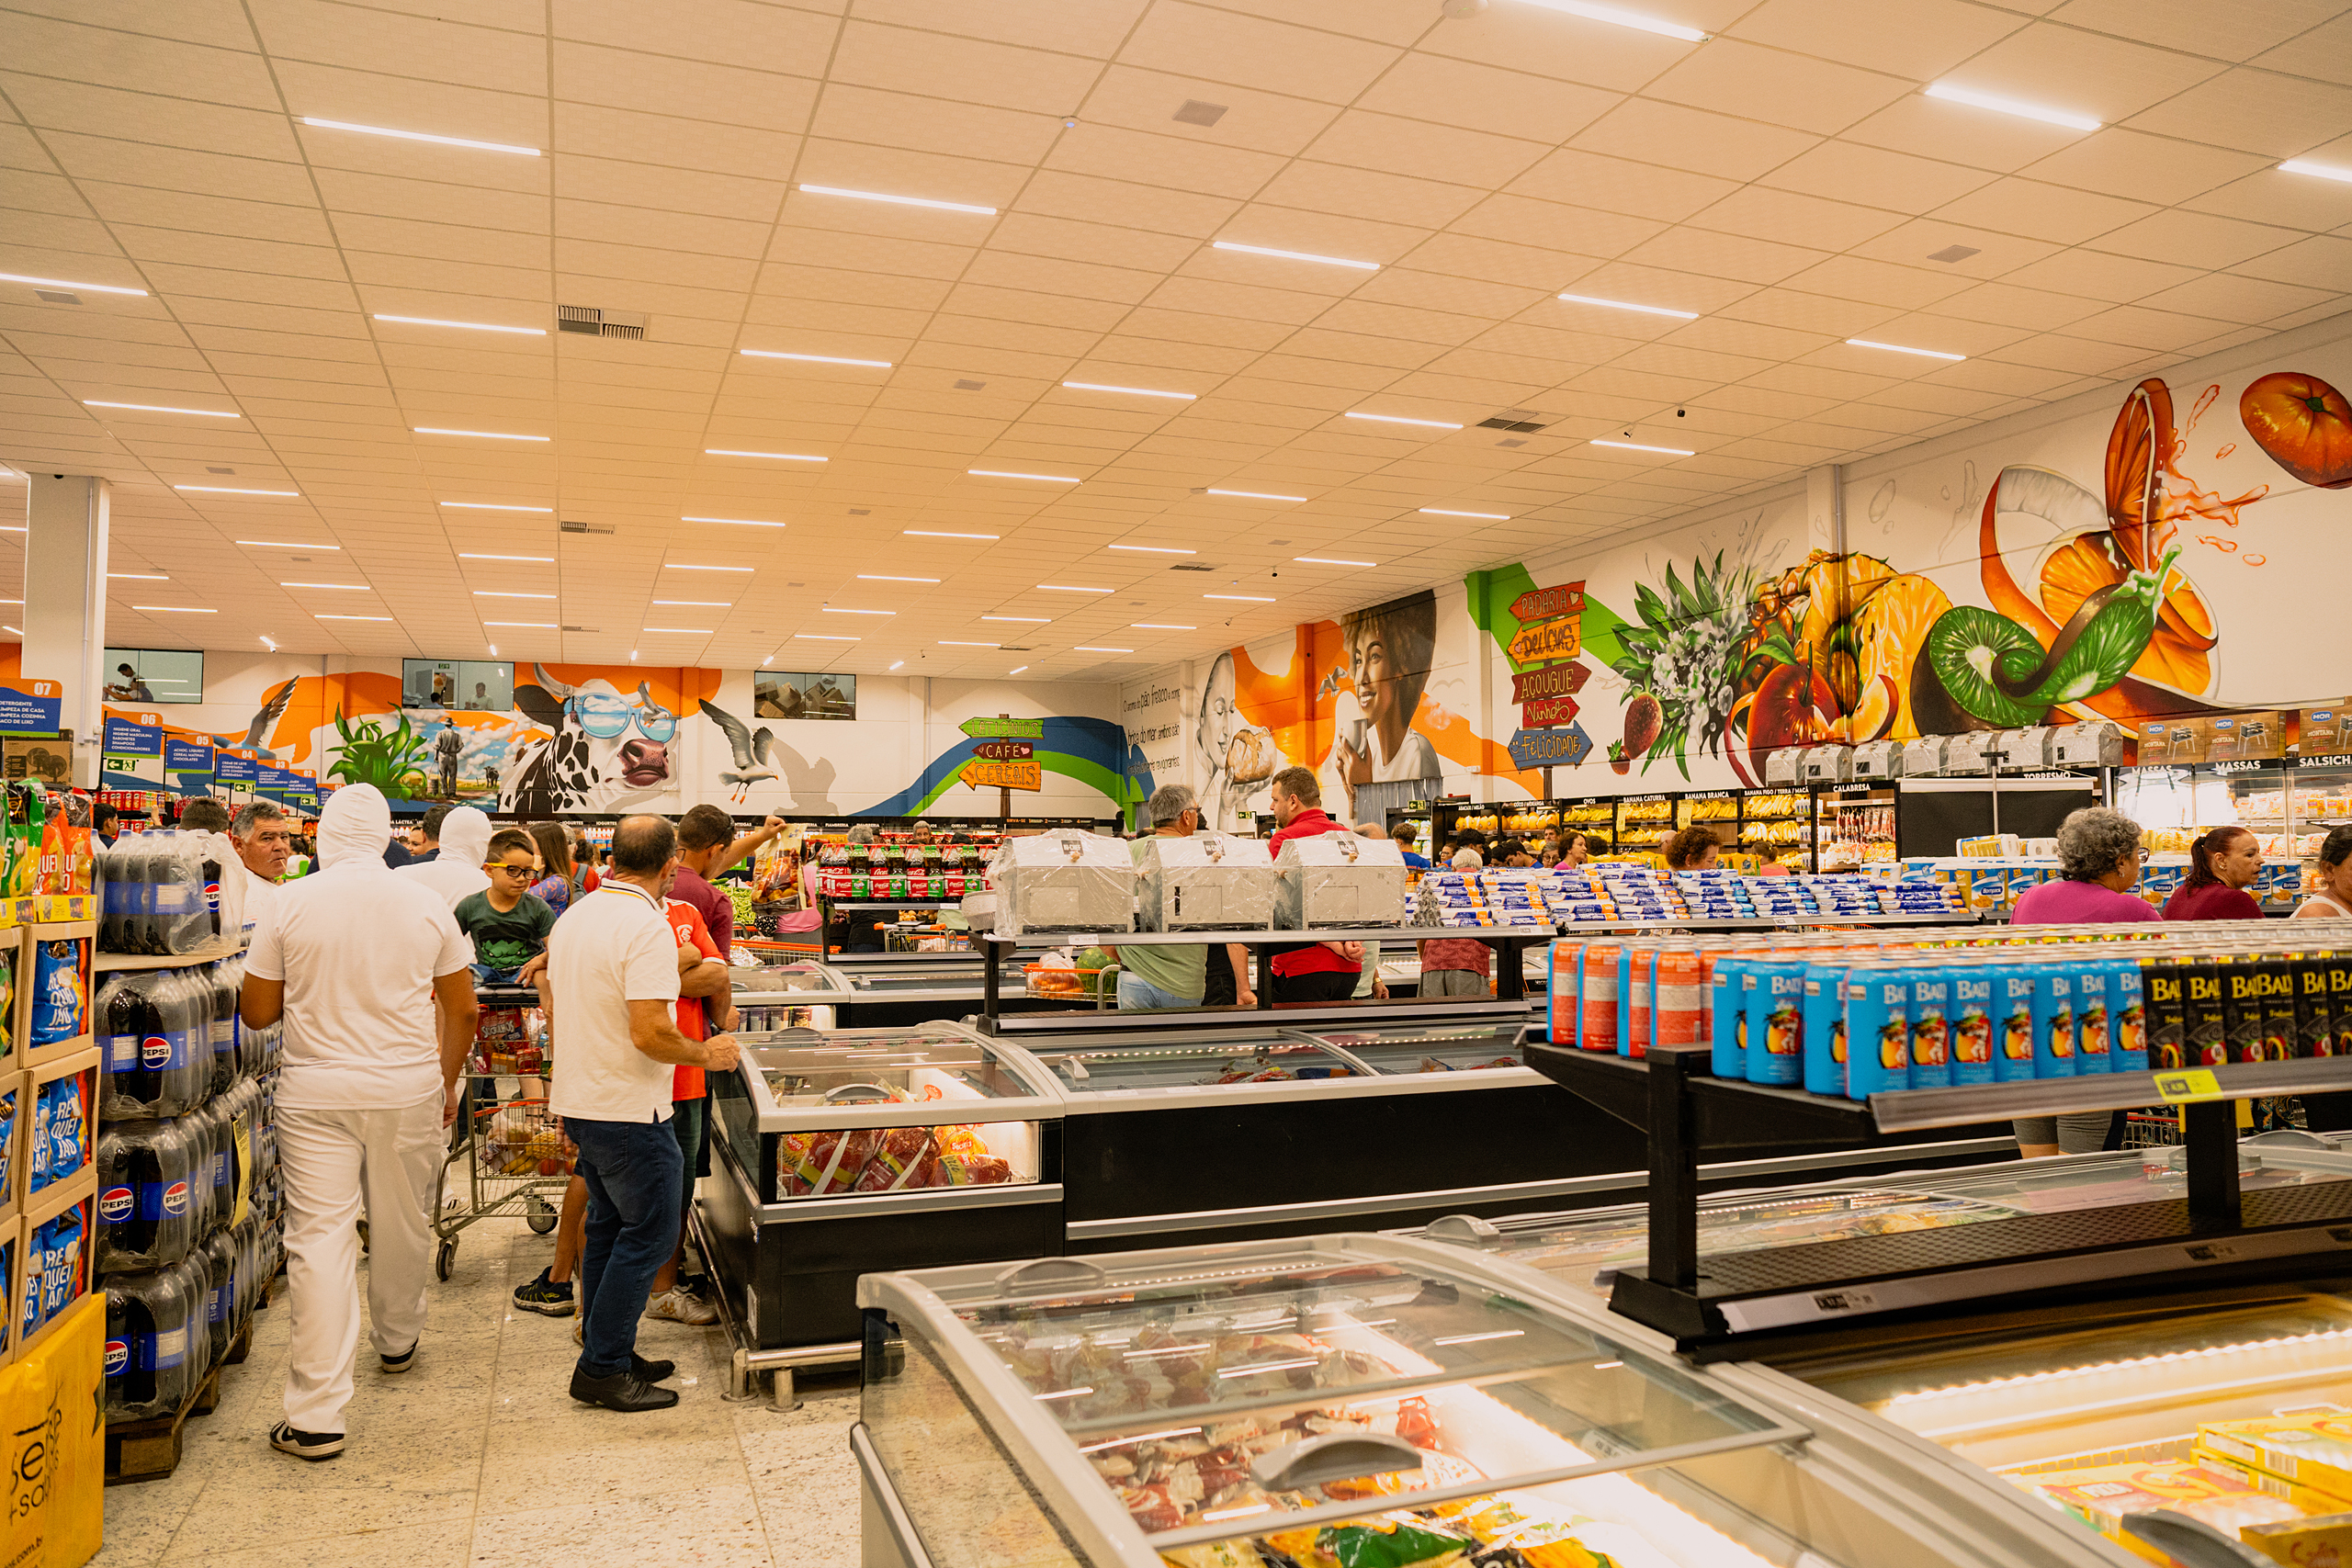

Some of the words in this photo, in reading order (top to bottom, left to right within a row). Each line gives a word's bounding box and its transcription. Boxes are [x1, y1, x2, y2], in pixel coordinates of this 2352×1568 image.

[1521, 589, 1567, 618] PADARIA
[34, 682, 51, 695] 07
[1521, 669, 1574, 699] AÇOUGUE
[1141, 692, 1149, 715] pão
[1151, 684, 1167, 706] fresco
[1526, 701, 1570, 723] Vinhos
[141, 714, 156, 725] 06
[972, 720, 1038, 736] LATICÍNIOS
[196, 736, 209, 745] 05
[242, 750, 252, 759] 04
[986, 743, 1020, 758] CAFÉ
[2215, 761, 2261, 771] MASSAS
[2300, 755, 2352, 767] SALSICH
[975, 765, 1035, 785] CEREAIS
[2132, 765, 2172, 775] MASSAS
[1833, 784, 1871, 793] CALABRESA
[142, 1047, 170, 1057] PEPSI
[56, 1100, 73, 1120] RE
[51, 1117, 77, 1140] QUEI
[101, 1197, 133, 1209] PEPSI
[44, 1264, 71, 1290] QUEI
